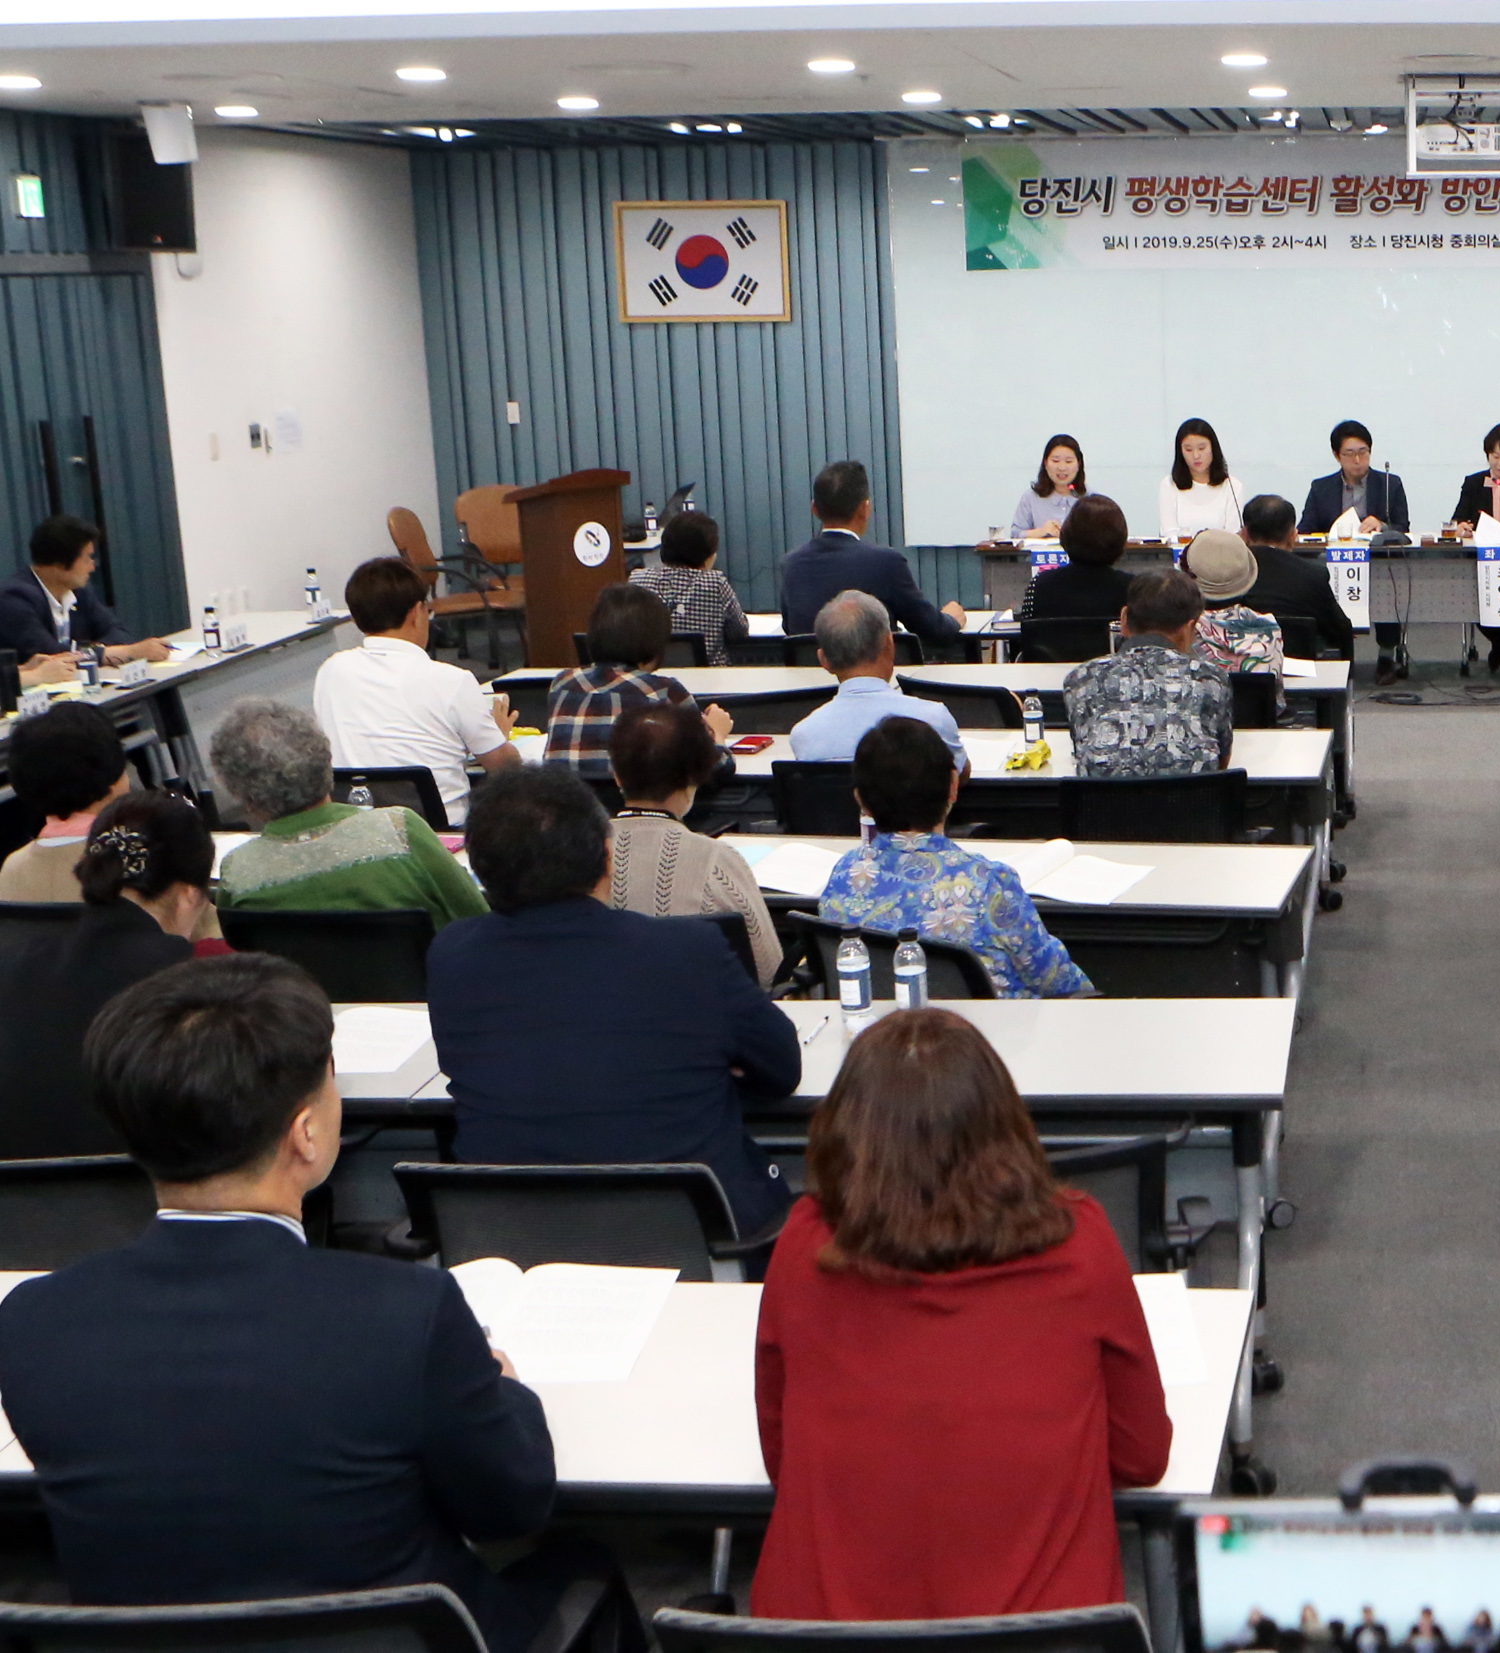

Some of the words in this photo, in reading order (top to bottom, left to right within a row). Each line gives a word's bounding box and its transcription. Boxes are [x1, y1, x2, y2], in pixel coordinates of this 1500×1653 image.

[1019, 176, 1114, 214] 당진시
[1124, 175, 1322, 214] 평생학습센터
[1330, 175, 1429, 214] 활성화
[1102, 235, 1129, 250] 일시
[1271, 235, 1327, 250] 2시~4시
[1349, 234, 1377, 249] 장소
[1390, 234, 1444, 249] 당진시청
[1331, 550, 1366, 561] 발제자
